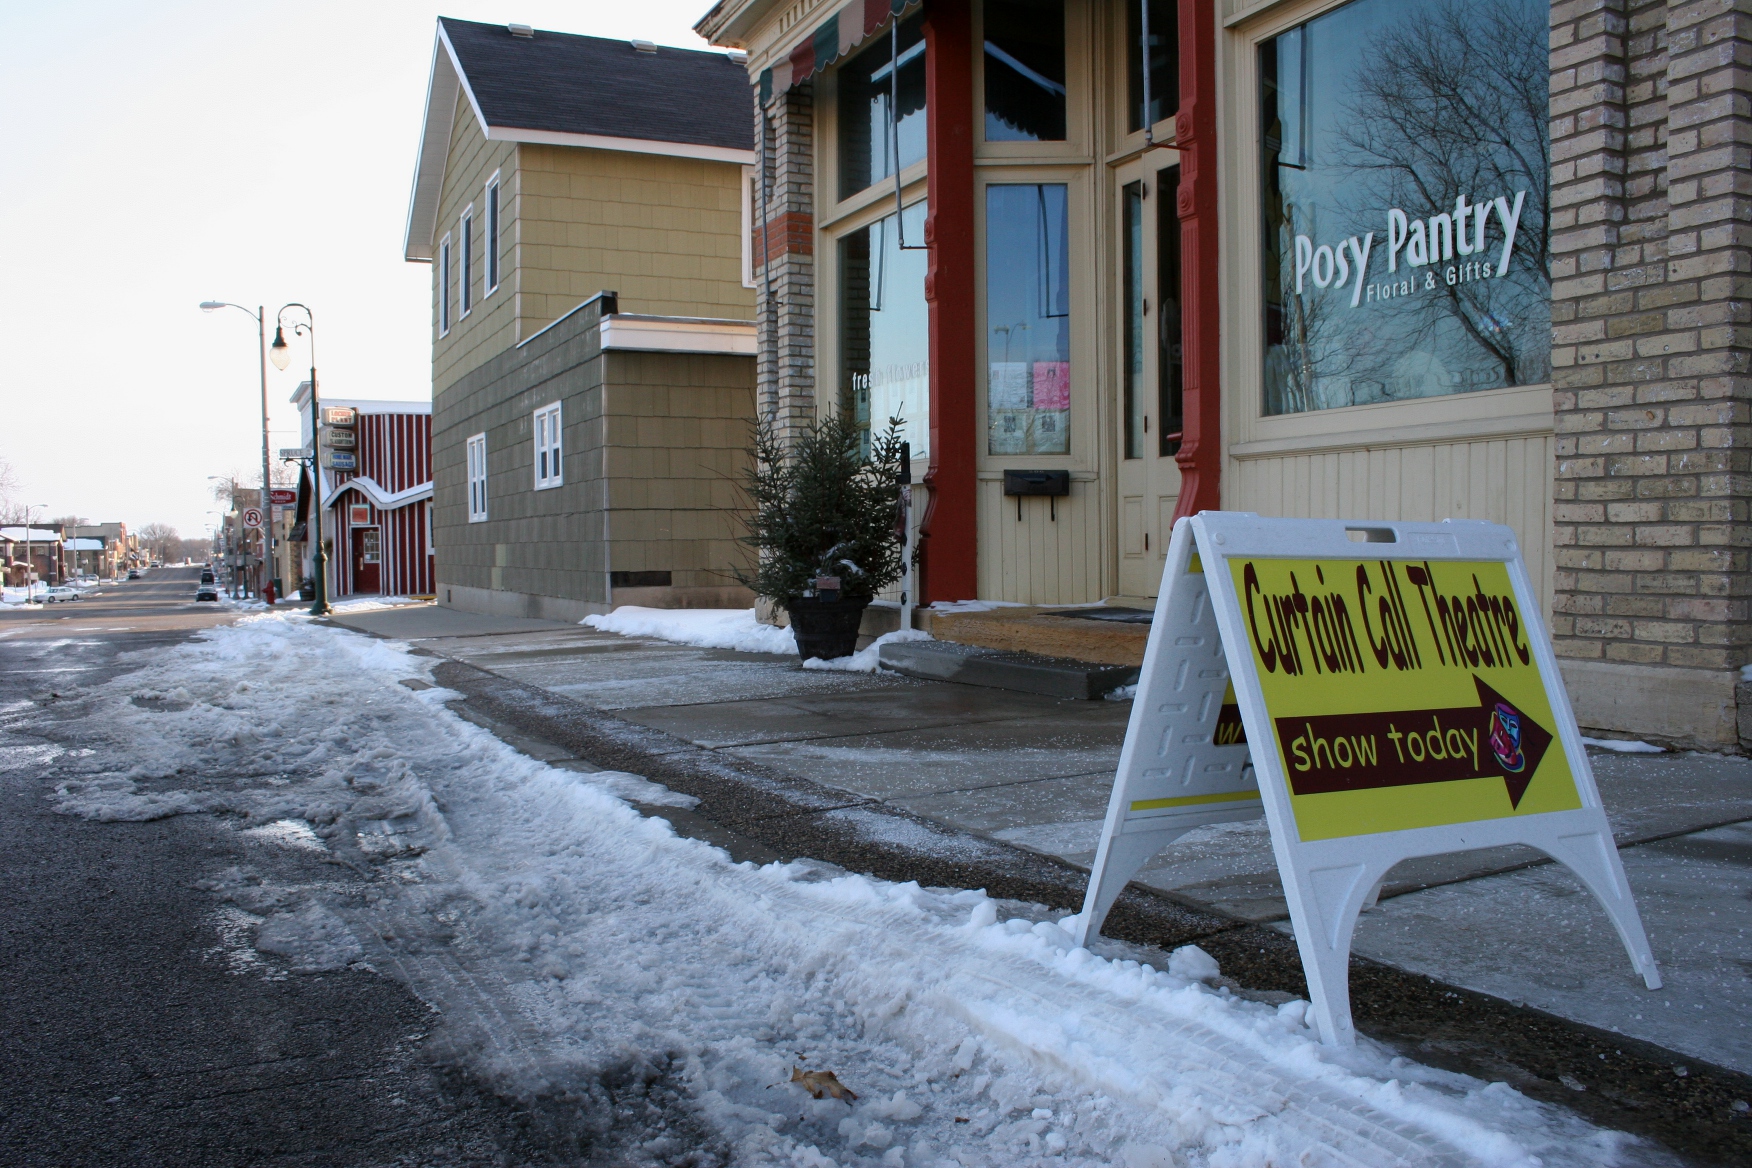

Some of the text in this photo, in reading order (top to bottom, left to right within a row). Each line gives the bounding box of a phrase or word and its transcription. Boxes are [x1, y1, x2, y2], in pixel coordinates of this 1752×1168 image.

[1295, 190, 1526, 308] Posy Pantry
[1367, 262, 1491, 302] Floral & Gifts
[852, 369, 884, 391] fresh
[331, 431, 353, 439] CUSTOM
[280, 449, 304, 457] SPRUCE
[332, 460, 354, 468] SAUSAGE
[1244, 560, 1530, 676] Curtain Call Theatre
[1291, 715, 1479, 771] show today
